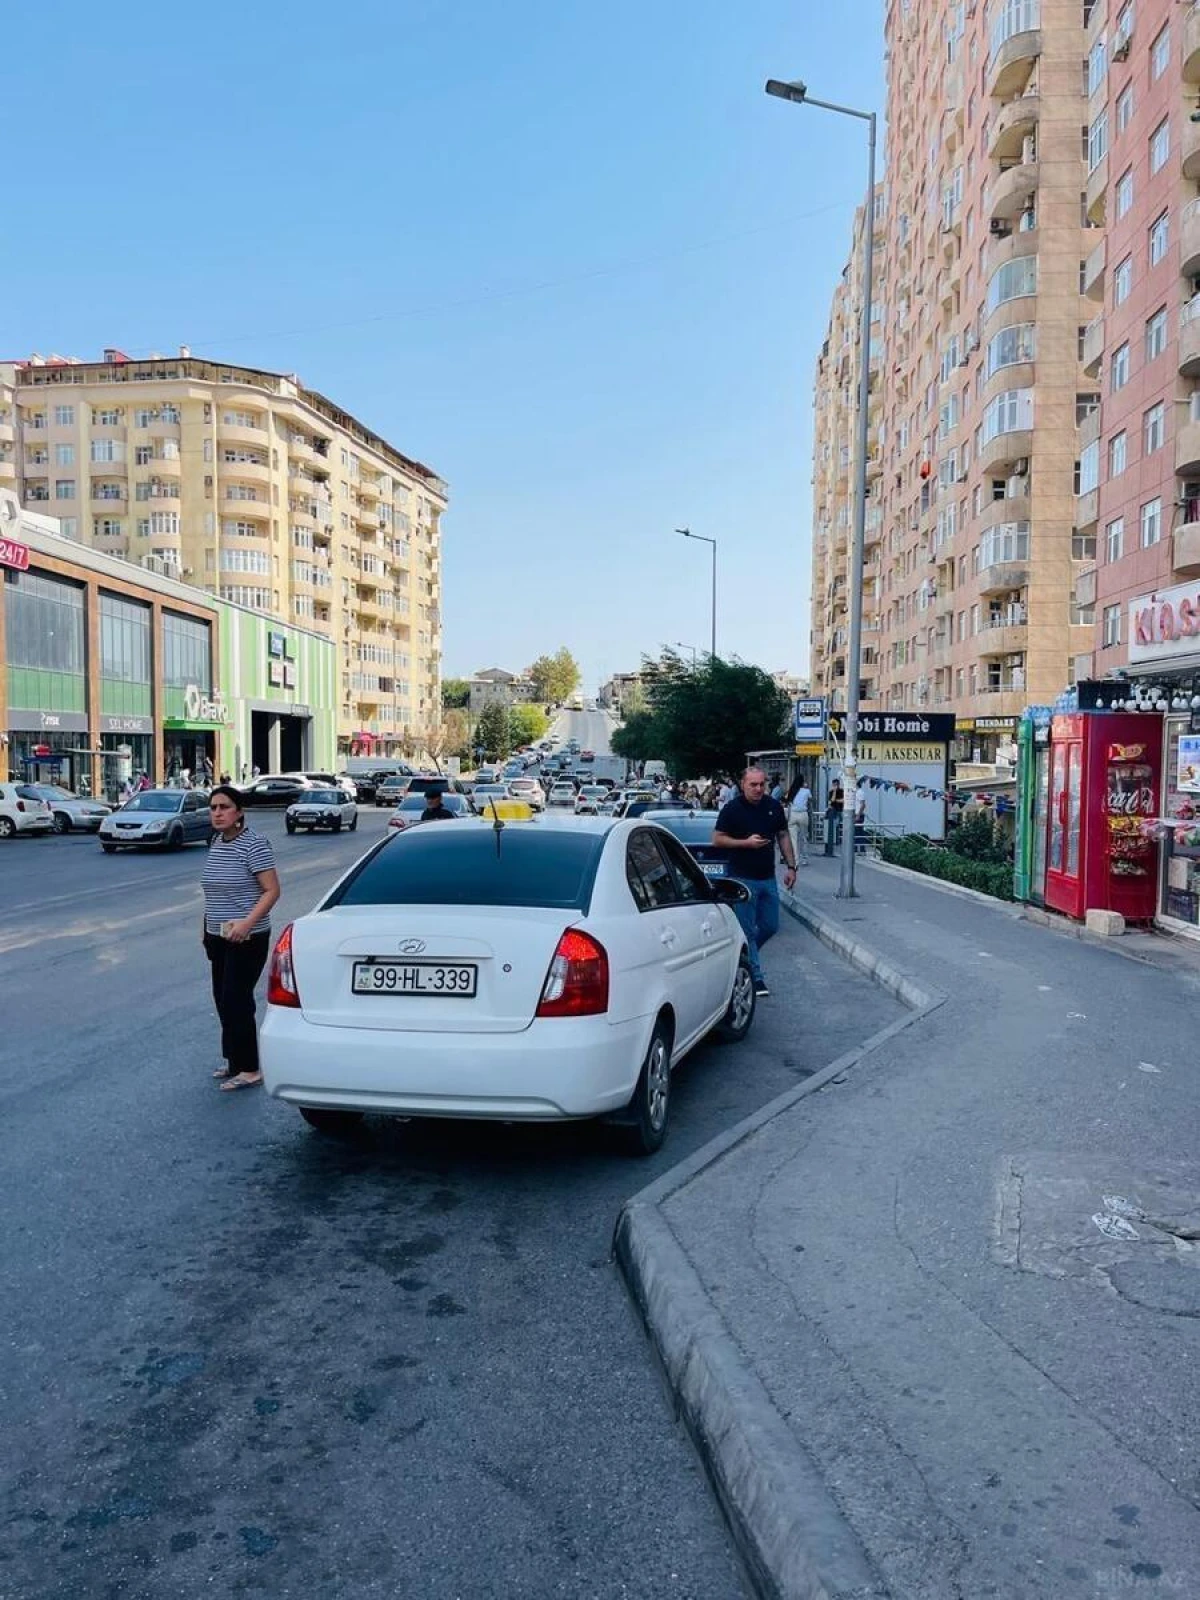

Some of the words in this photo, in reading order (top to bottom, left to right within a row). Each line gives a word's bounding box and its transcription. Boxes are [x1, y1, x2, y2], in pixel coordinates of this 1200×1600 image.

[883, 717, 930, 733] Home
[884, 747, 941, 761] AKSESUAR
[373, 967, 470, 990] 99-HL-339
